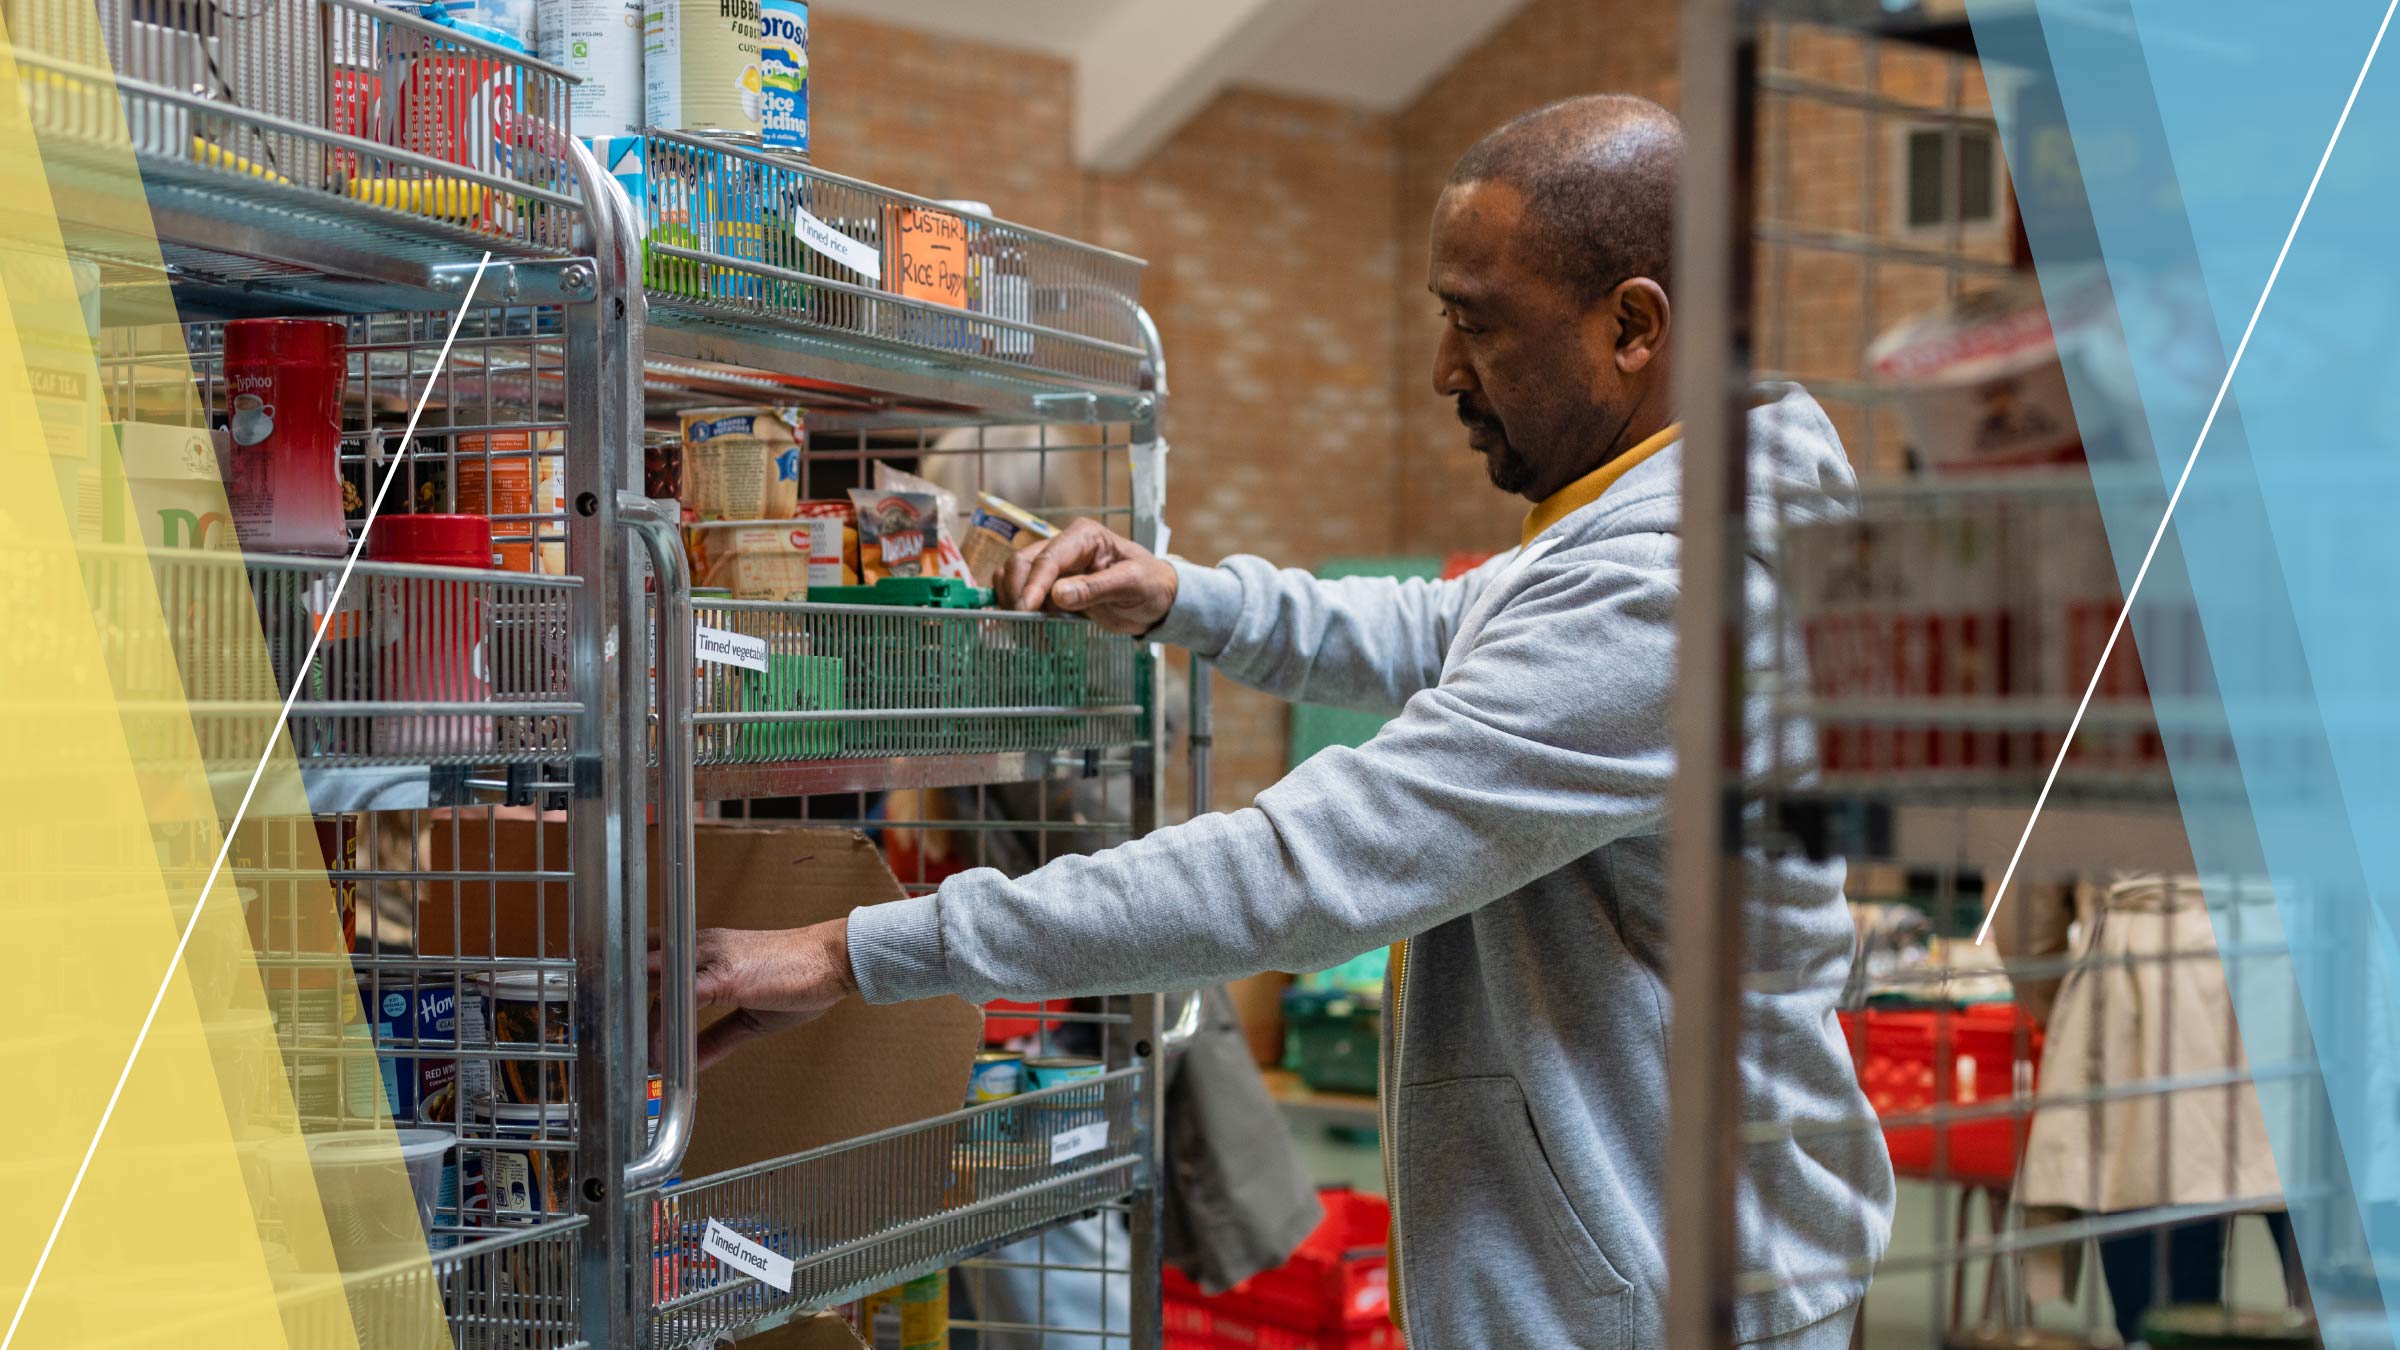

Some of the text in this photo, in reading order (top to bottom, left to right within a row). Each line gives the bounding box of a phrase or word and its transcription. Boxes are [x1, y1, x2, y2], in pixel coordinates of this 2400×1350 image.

[720, 0, 760, 22] HUBBA
[801, 216, 848, 255] Tinned rice
[902, 253, 934, 287] RICE
[59, 375, 79, 396] TEA
[235, 375, 273, 392] Typhoo
[699, 634, 731, 655] Tinned
[425, 1069, 442, 1080] RED
[711, 1227, 741, 1257] Tinned
[740, 1249, 768, 1271] meat
